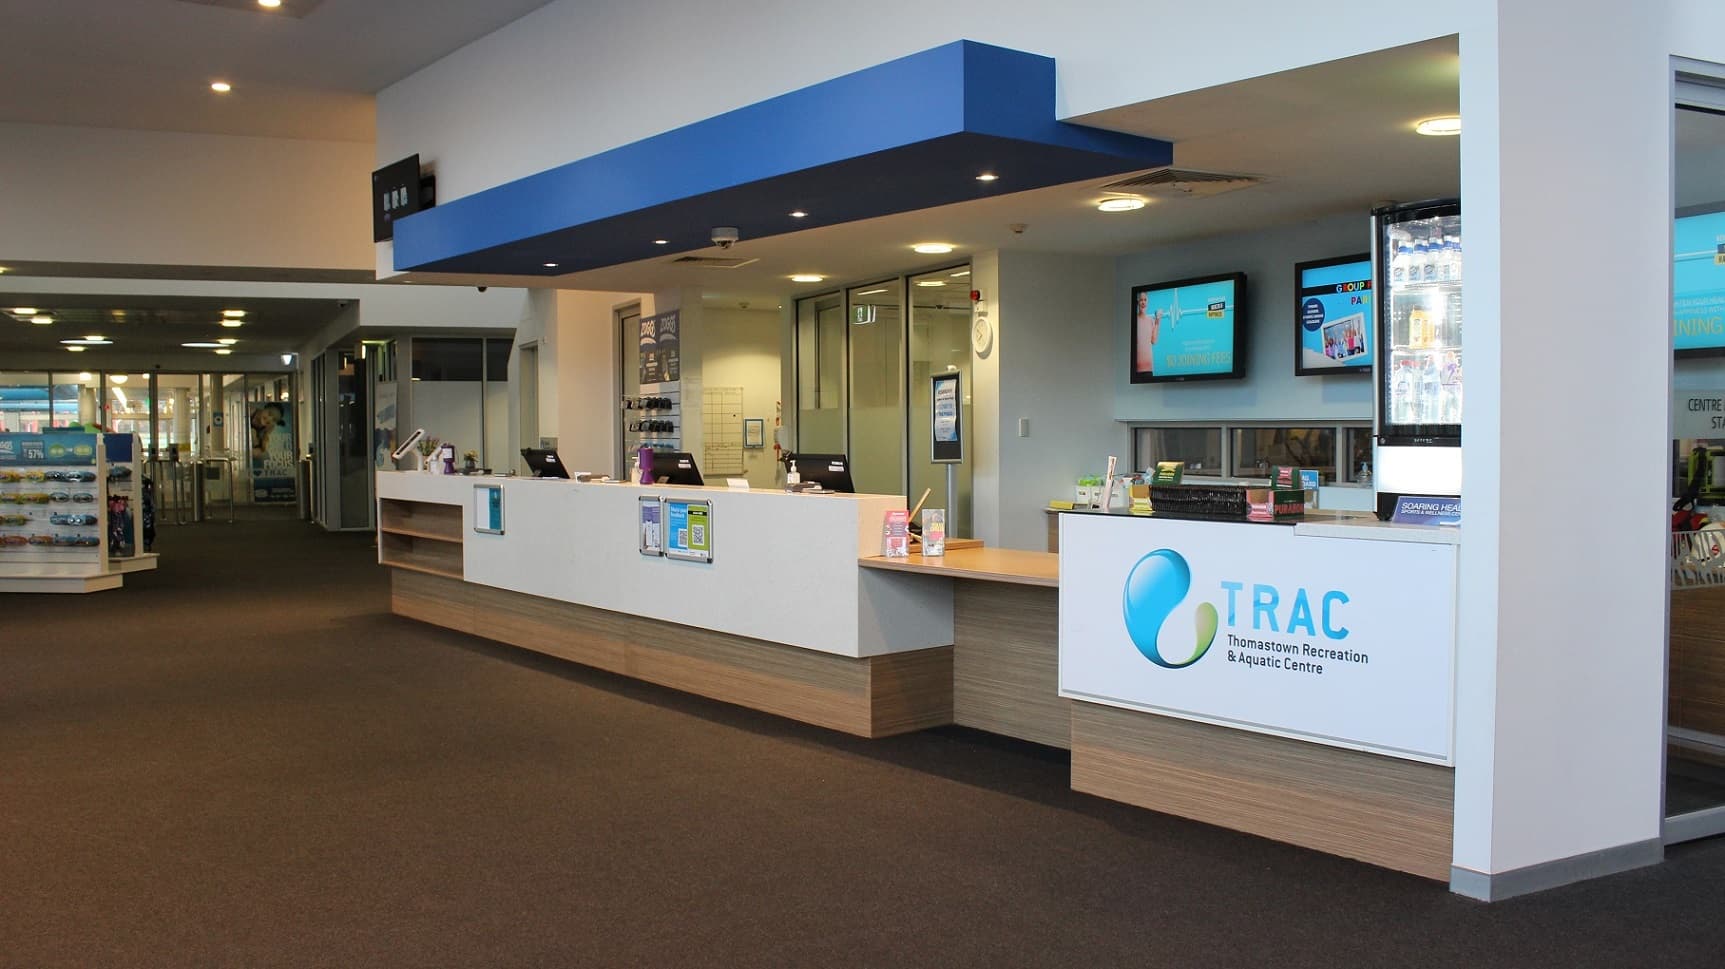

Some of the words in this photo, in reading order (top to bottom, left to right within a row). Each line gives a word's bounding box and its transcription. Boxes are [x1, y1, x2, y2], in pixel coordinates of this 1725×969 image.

[1336, 282, 1365, 293] GROUP
[1688, 398, 1723, 412] CENTRE
[1402, 502, 1439, 511] SOARING
[1221, 580, 1350, 640] TRAC
[1227, 634, 1299, 655] Thomastown
[1302, 643, 1369, 665] Recreation
[1227, 650, 1237, 662] &
[1238, 651, 1281, 669] Aquatic
[1284, 658, 1323, 675] Centre
